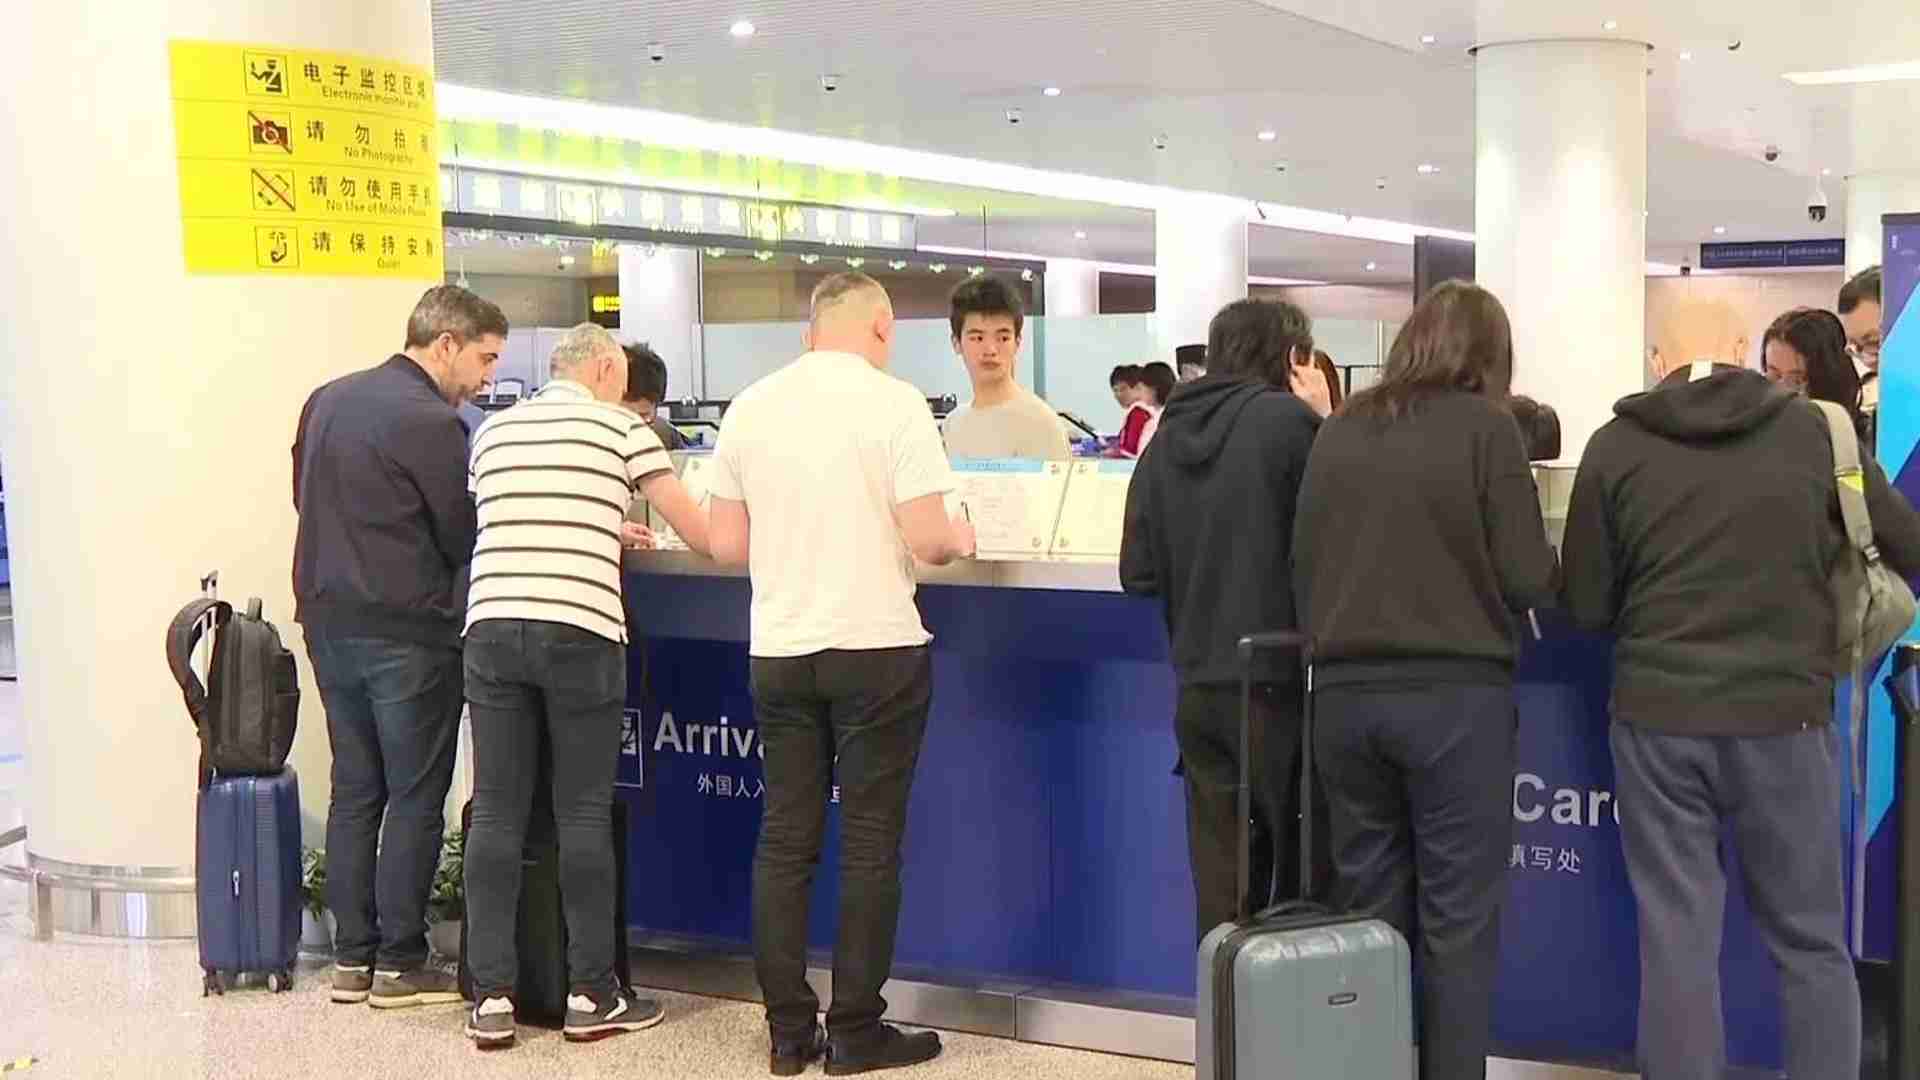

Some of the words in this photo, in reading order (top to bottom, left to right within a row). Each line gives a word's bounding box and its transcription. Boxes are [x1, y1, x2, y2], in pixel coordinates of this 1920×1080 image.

[344, 146, 360, 158] No
[326, 199, 343, 212] No
[1513, 773, 1620, 826] Car
